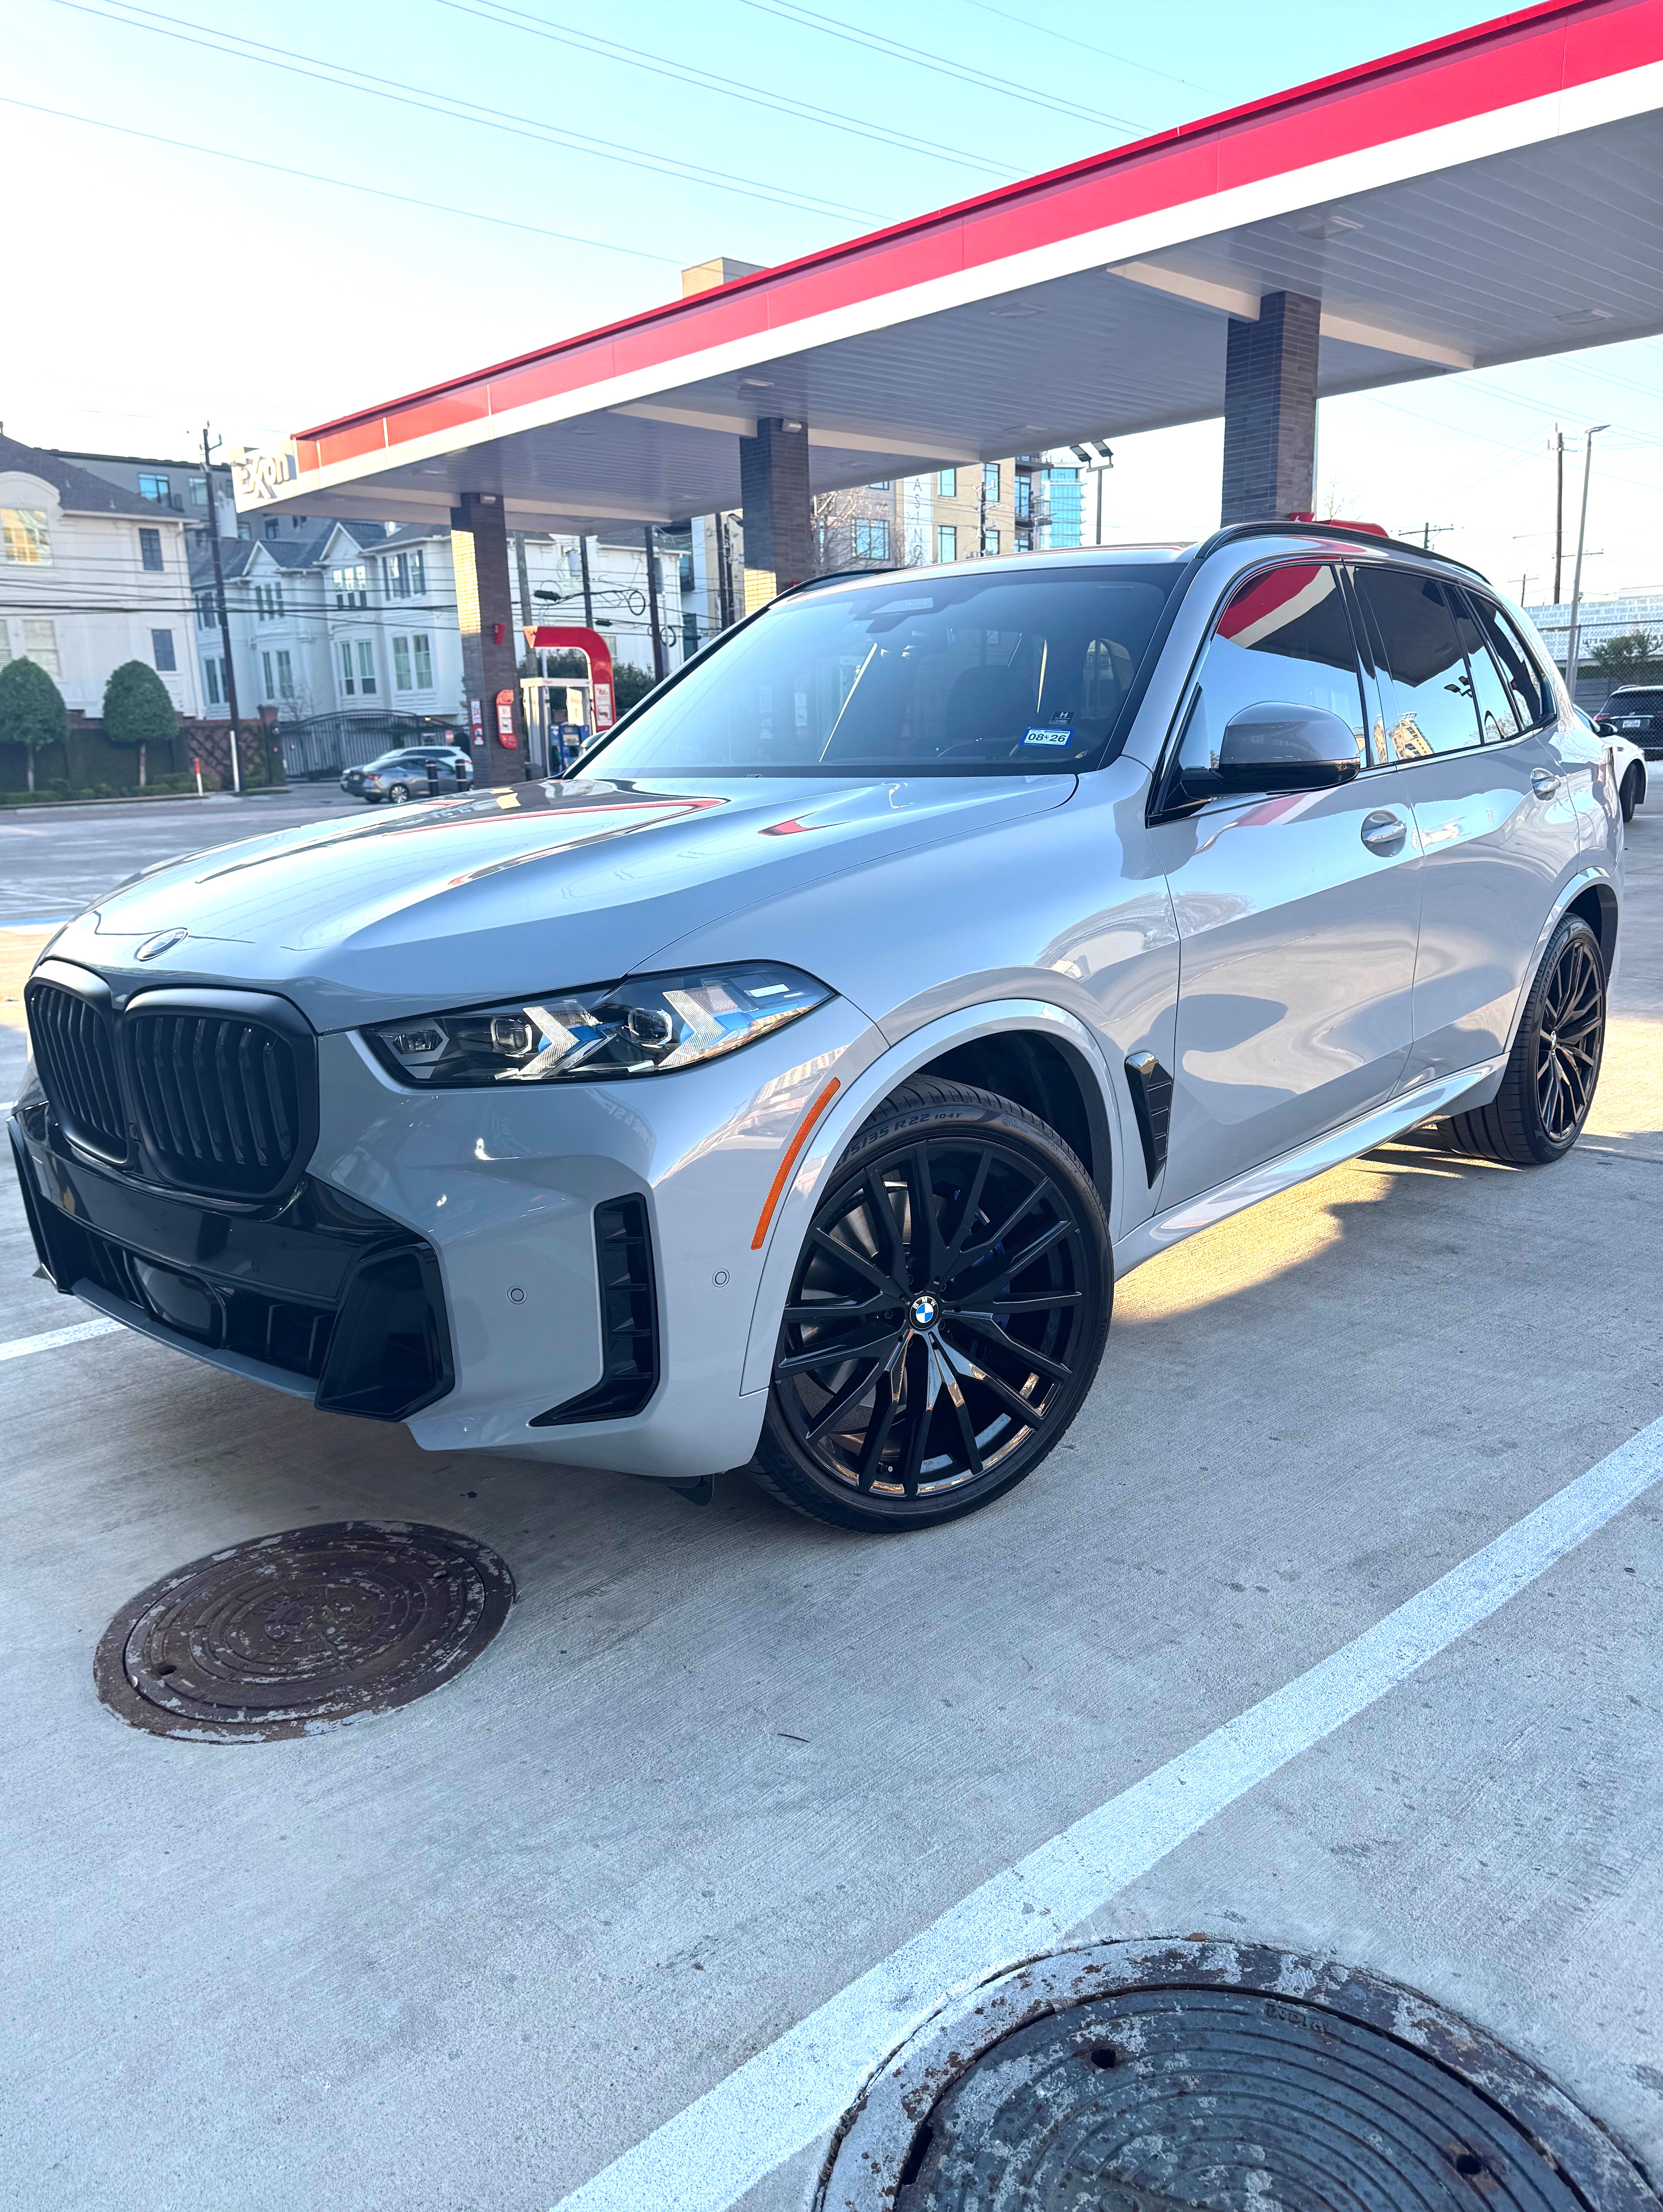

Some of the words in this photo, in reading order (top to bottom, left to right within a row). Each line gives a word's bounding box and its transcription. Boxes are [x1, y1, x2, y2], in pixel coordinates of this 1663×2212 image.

[836, 1125, 889, 1167] 75/35
[894, 1113, 931, 1131] R22
[913, 1297, 936, 1309] BMW
